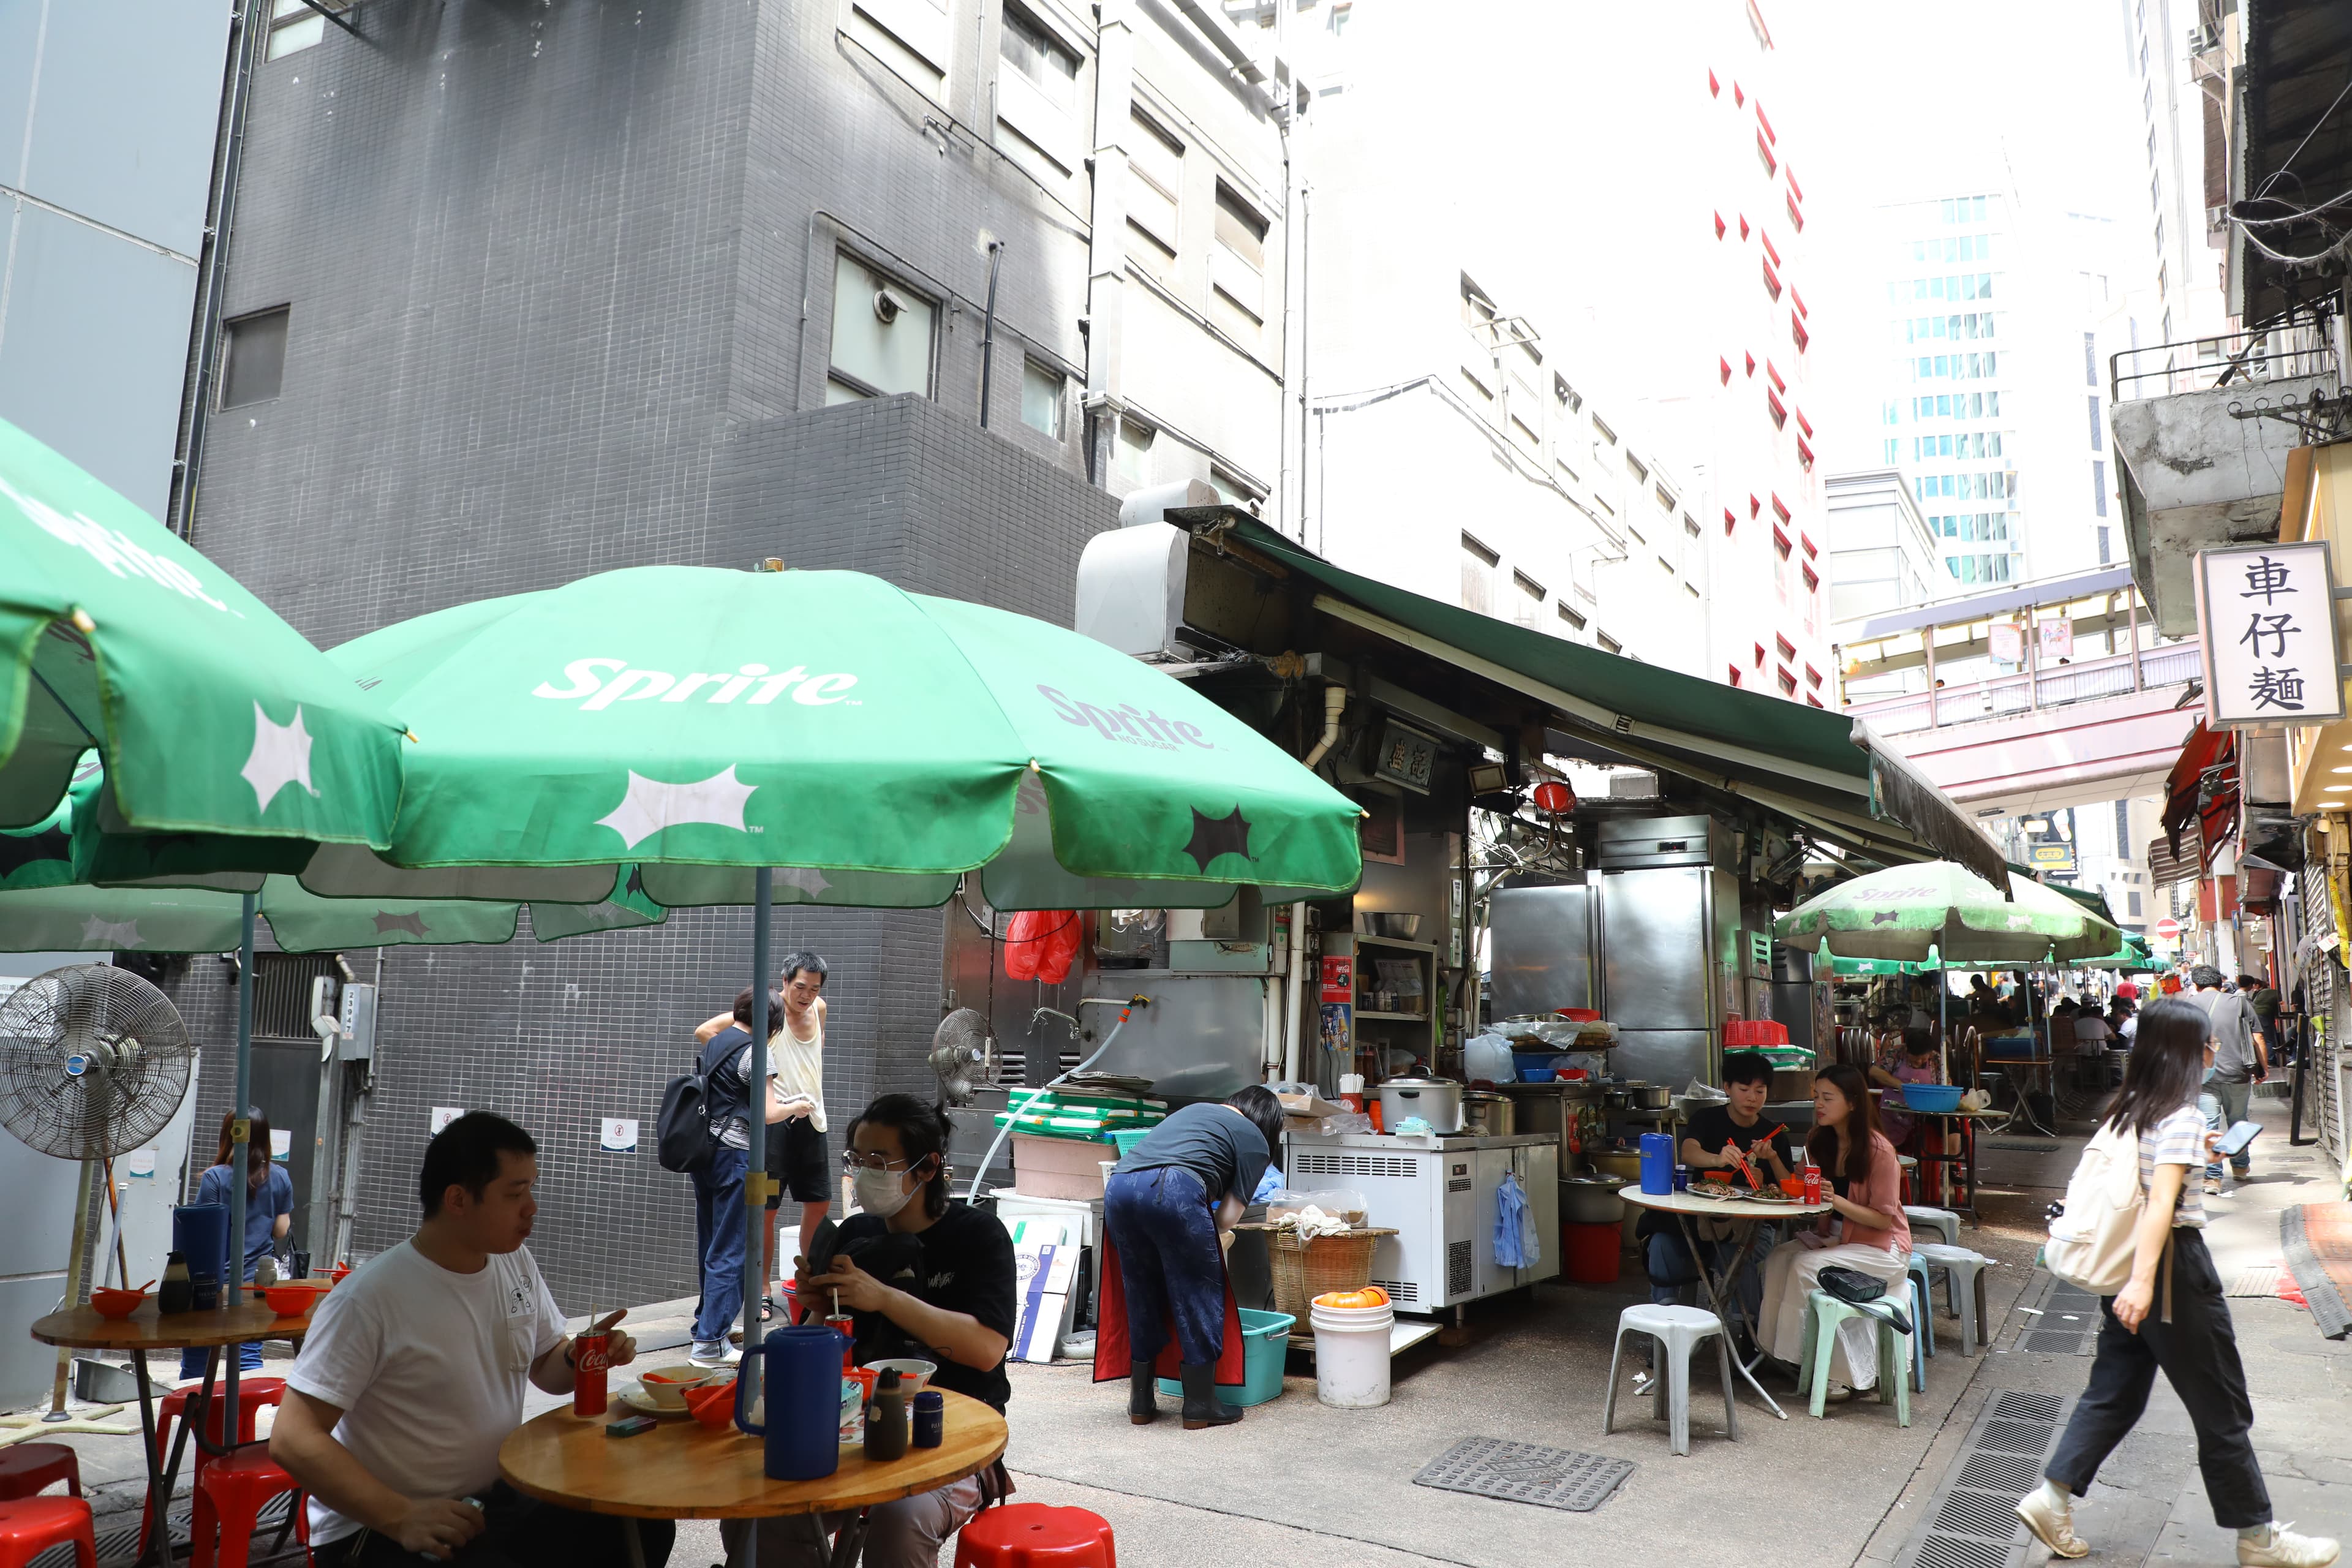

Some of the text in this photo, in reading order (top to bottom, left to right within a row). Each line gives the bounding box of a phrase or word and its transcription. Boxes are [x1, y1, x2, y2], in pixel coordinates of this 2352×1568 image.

[2239, 556, 2305, 711] 車仔麵
[531, 658, 858, 710] Sprite
[1036, 684, 1215, 750] Sprite
[1118, 734, 1180, 752] NO SUGAR
[1853, 887, 1937, 902] Sprite
